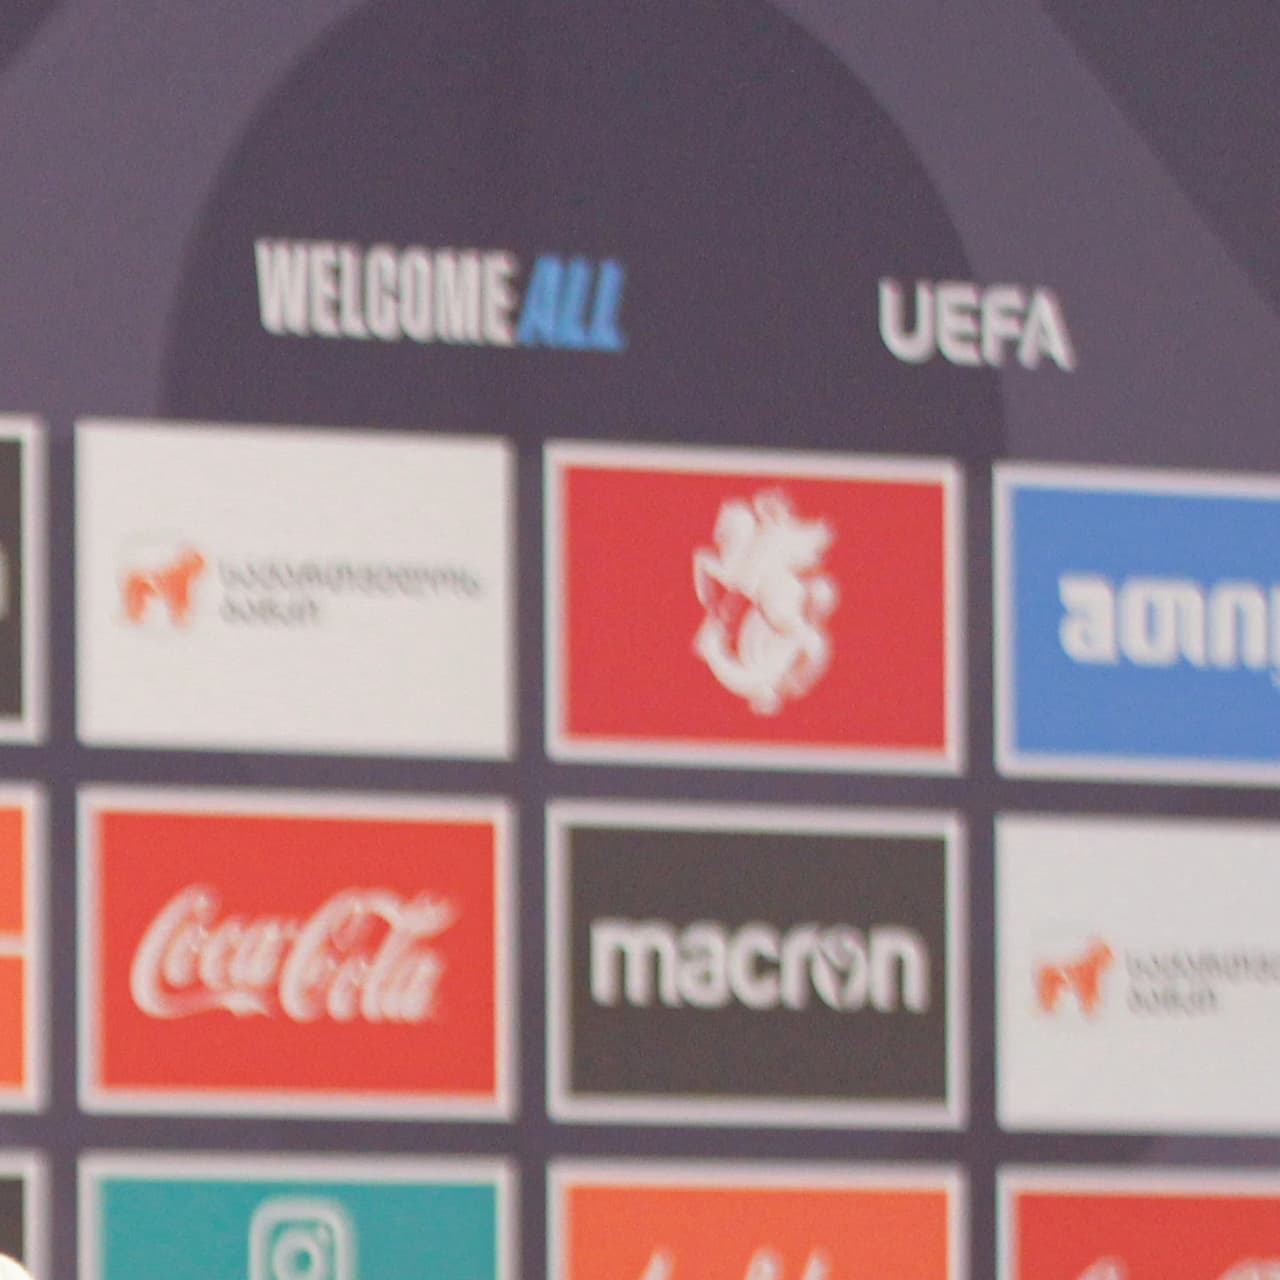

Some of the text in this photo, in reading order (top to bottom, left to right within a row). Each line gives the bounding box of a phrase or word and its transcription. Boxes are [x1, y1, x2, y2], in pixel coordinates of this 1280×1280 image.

[254, 240, 627, 351] WELCOME ALL
[878, 278, 1076, 371] UEFA
[590, 918, 929, 1013] macron
